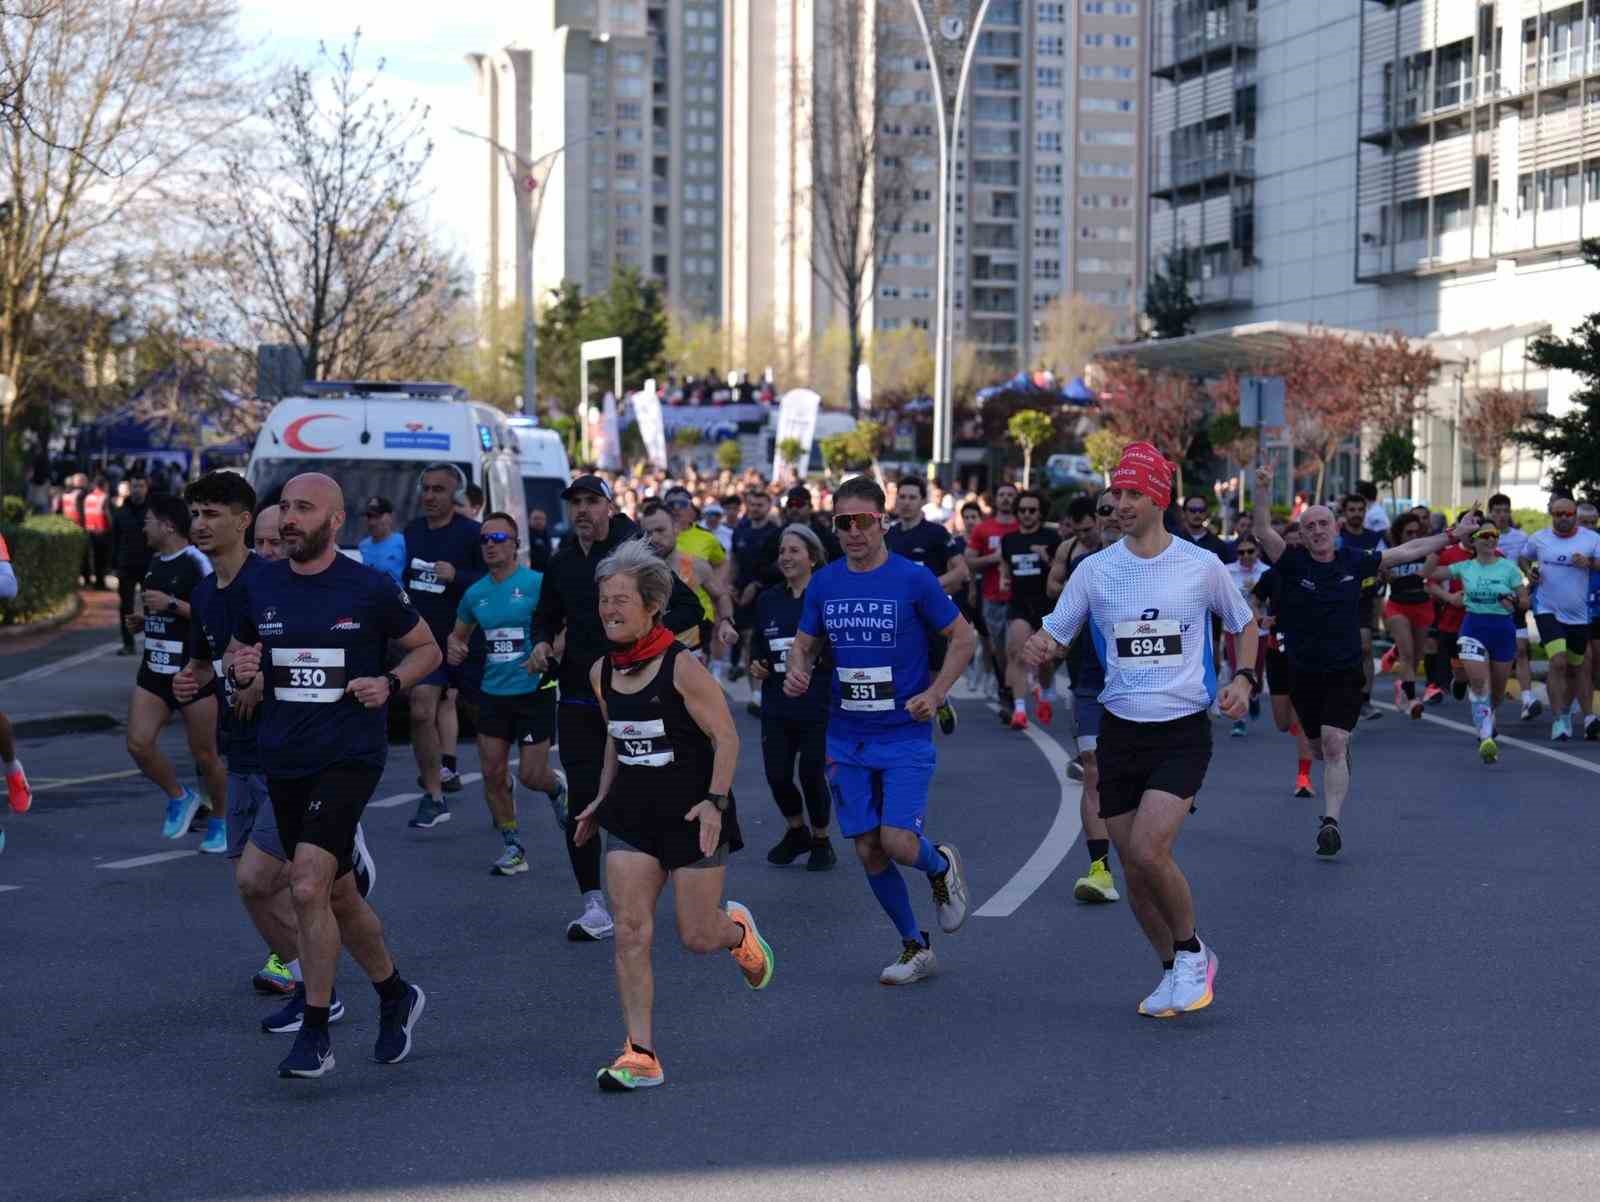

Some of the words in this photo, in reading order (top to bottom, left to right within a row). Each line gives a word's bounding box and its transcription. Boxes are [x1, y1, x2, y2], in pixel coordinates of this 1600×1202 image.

[825, 602, 893, 615] SHAPE
[825, 617, 895, 630] RUNNING
[828, 631, 893, 642] CLUB
[494, 641, 514, 653] 588
[1130, 638, 1166, 655] 694
[289, 668, 327, 687] 330
[850, 684, 876, 700] 351
[624, 740, 653, 756] 427
